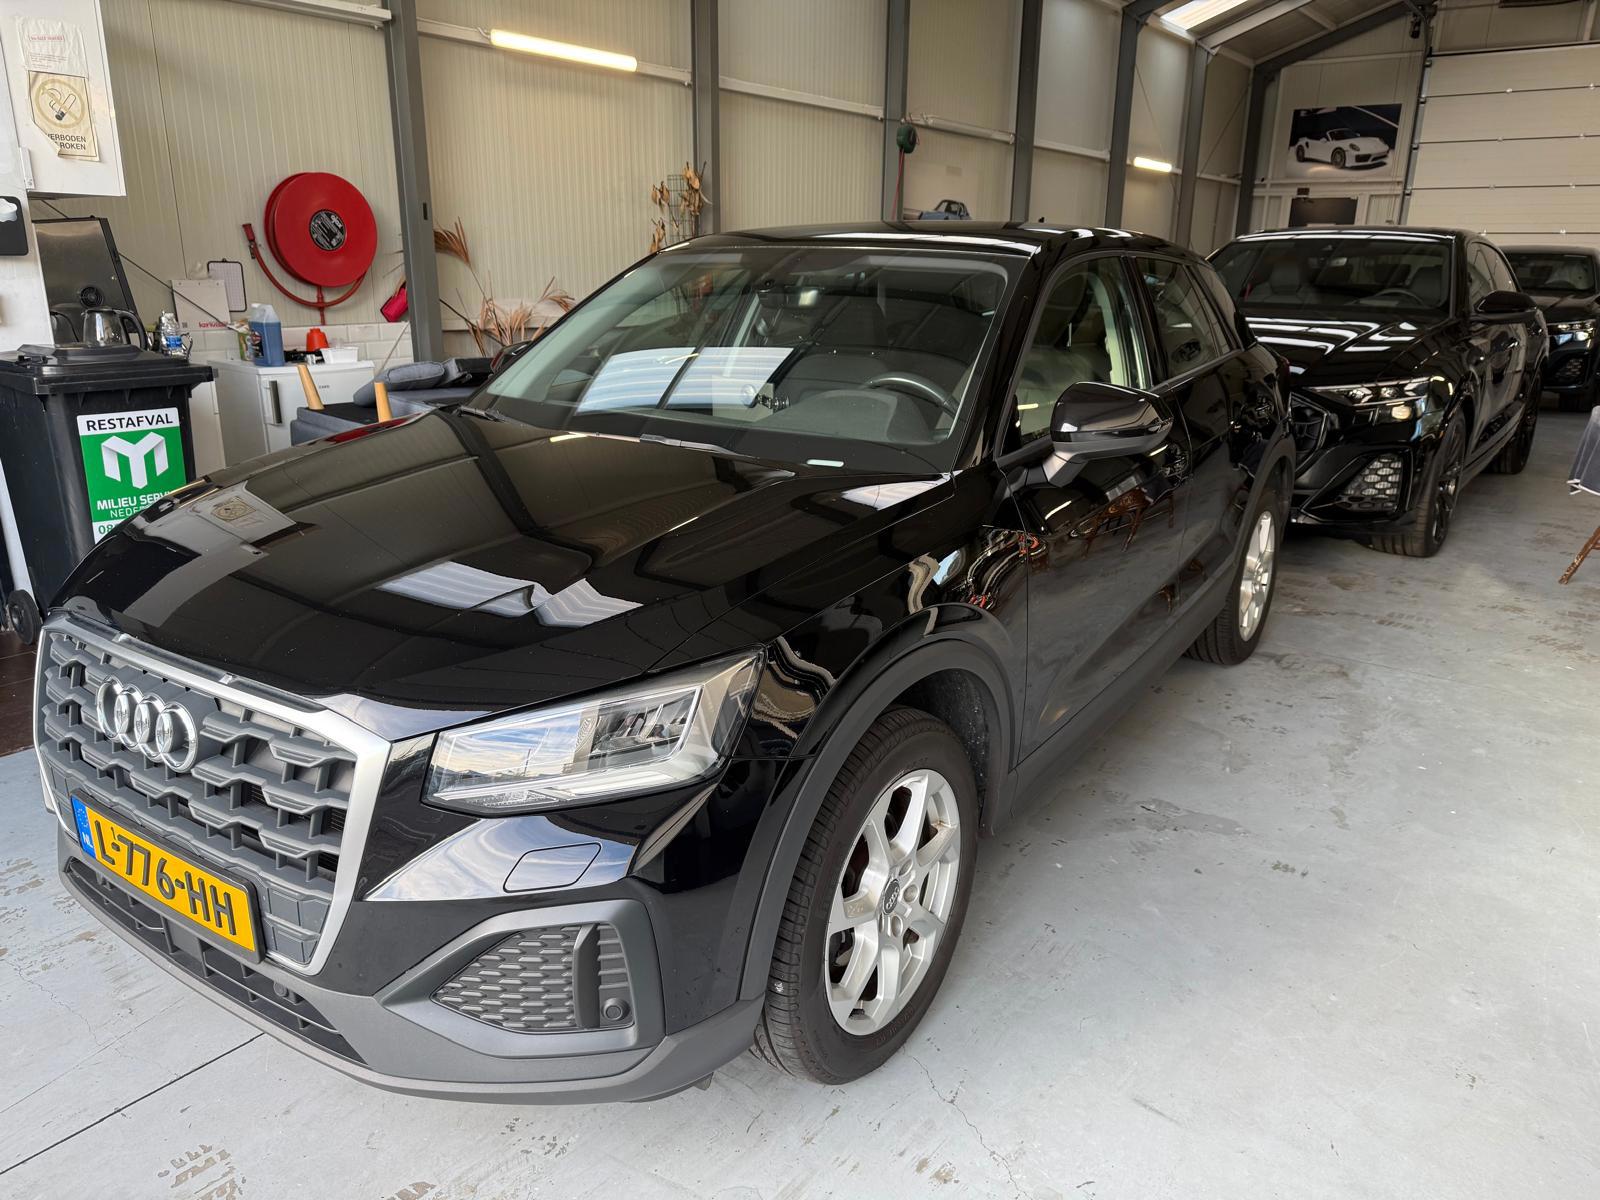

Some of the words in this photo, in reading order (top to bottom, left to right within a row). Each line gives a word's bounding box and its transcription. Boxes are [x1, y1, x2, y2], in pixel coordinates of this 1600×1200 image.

[60, 142, 86, 150] ROKEN
[86, 413, 173, 431] RESTAFVAL
[97, 496, 137, 510] MILIEU
[81, 831, 94, 849] NL
[95, 820, 237, 936] L-776-HH
